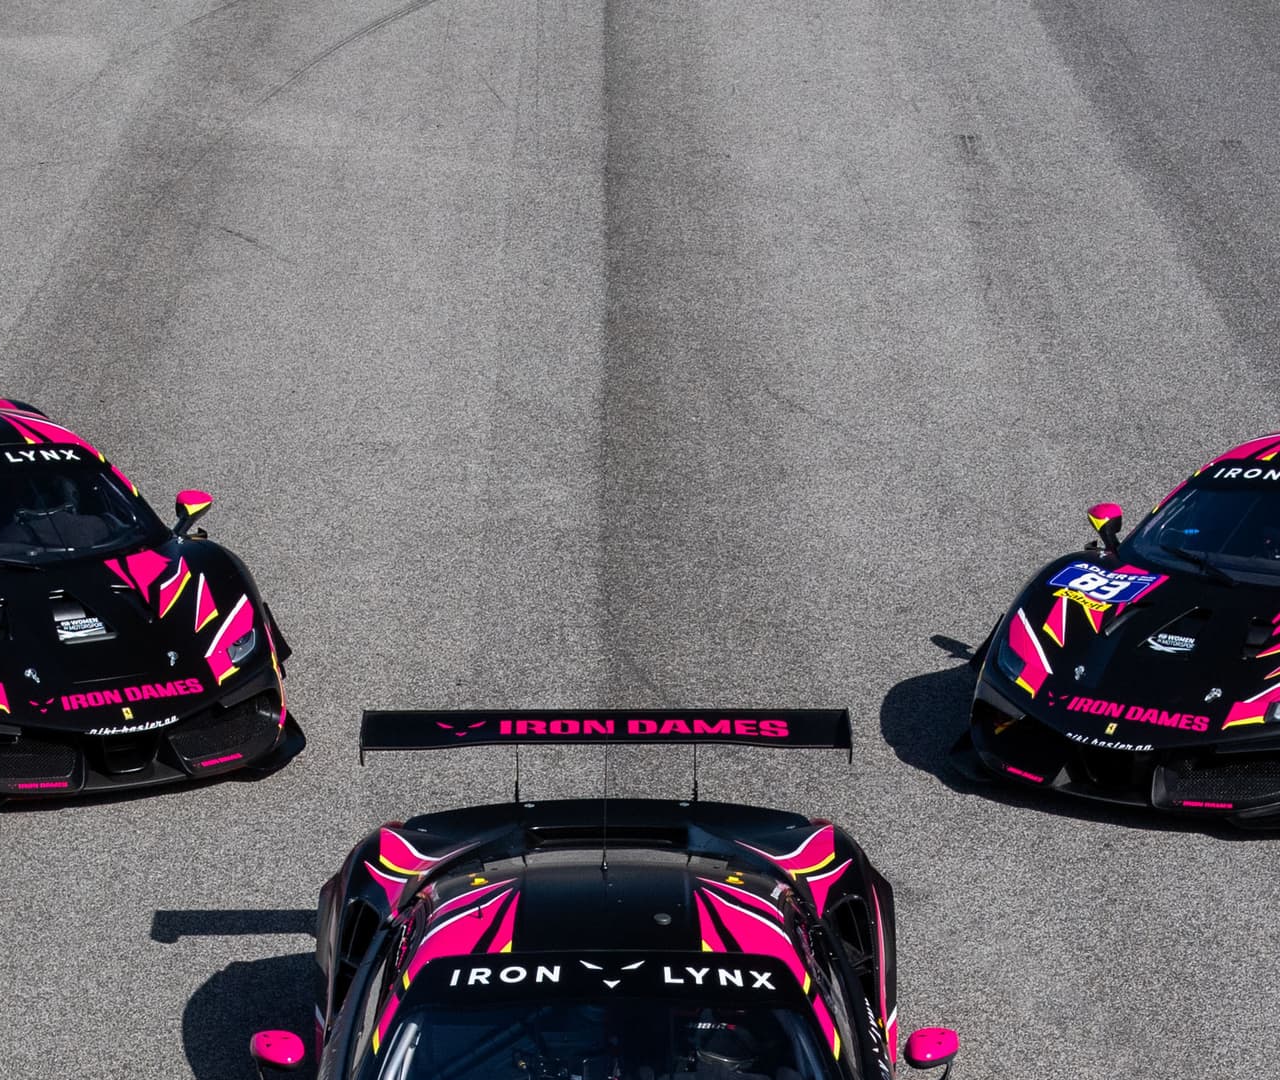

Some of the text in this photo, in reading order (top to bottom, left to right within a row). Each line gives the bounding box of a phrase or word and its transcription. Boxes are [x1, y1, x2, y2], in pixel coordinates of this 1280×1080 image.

[5, 450, 81, 463] LYNX
[1074, 563, 1130, 581] ADLER
[1069, 573, 1130, 600] 83
[61, 678, 204, 711] IRON DAMES
[1067, 696, 1210, 732] IRON DAMES
[499, 719, 790, 737] IRON DAMES
[450, 965, 777, 991] IRON LYNX
